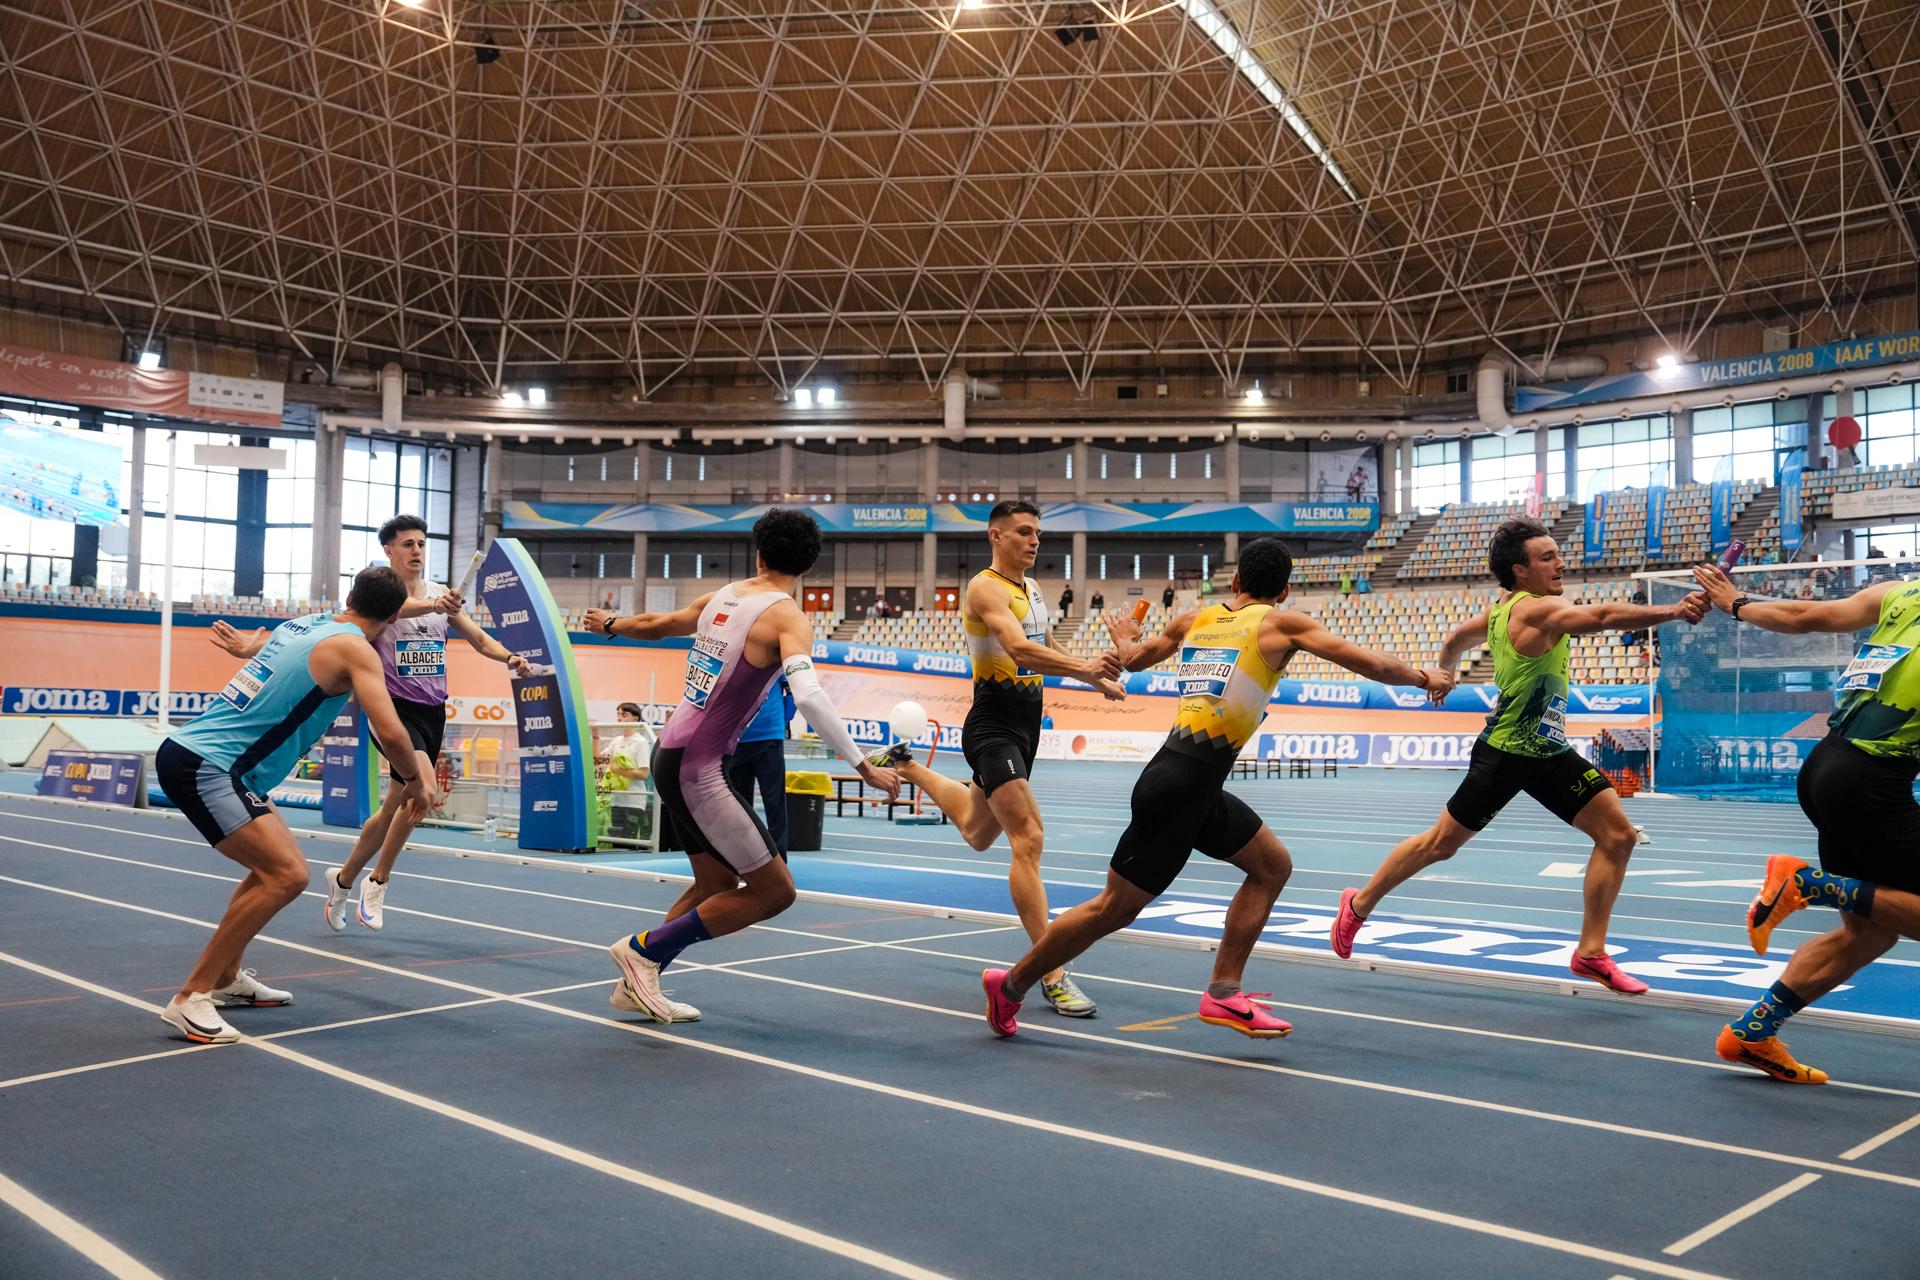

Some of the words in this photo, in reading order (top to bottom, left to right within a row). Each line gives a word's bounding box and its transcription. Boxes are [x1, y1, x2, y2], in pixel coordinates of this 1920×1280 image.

[1835, 342, 1874, 364] IAAF
[59, 362, 82, 375] con
[1700, 358, 1774, 382] VALENCIA
[1777, 351, 1814, 372] 2008
[853, 508, 902, 520] VALENCIA
[904, 508, 928, 520] 2008
[1294, 507, 1344, 520] VALENCIA
[1347, 507, 1371, 520] 2008
[400, 650, 444, 665] ALBACETE
[844, 645, 899, 665] Joma
[912, 653, 967, 674] Joma
[408, 665, 438, 676] Joma
[1179, 662, 1232, 678] GRUPOMPLEO
[520, 685, 549, 702] COPA
[1183, 681, 1210, 694] Joma
[1297, 683, 1362, 704] Joma
[13, 688, 110, 713] Joma
[472, 703, 505, 721] GO
[524, 715, 554, 733] Joma
[1267, 735, 1359, 760] Joma
